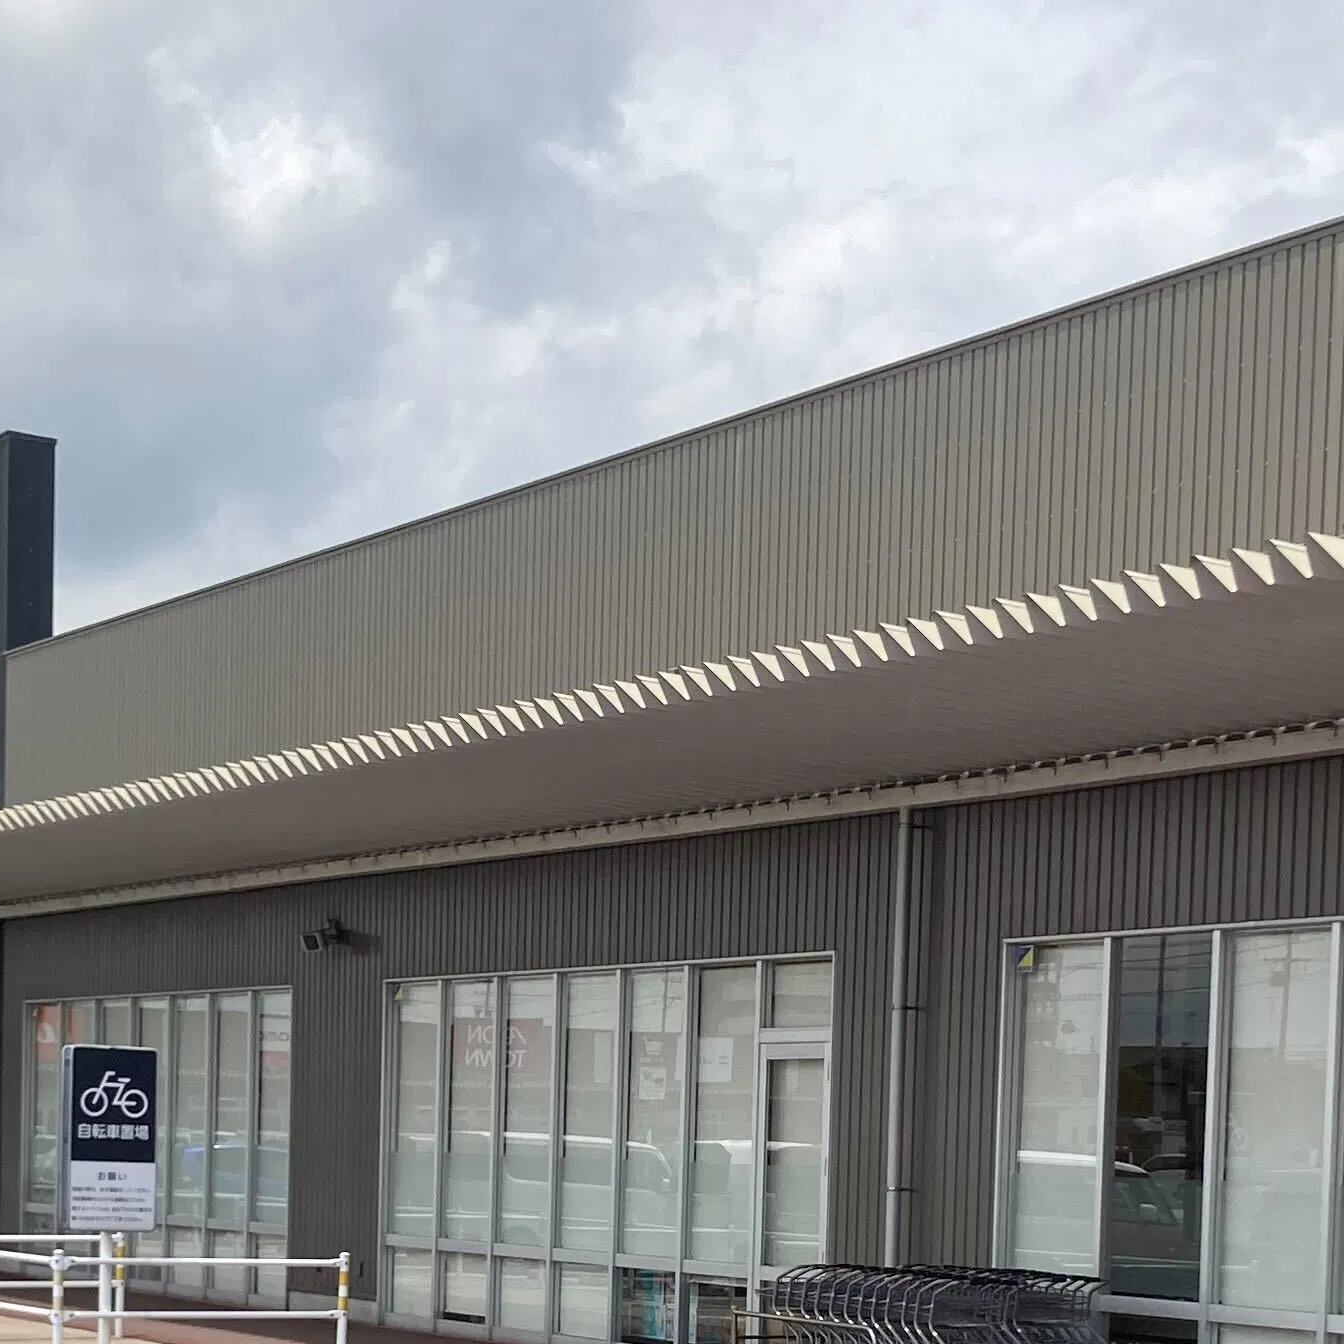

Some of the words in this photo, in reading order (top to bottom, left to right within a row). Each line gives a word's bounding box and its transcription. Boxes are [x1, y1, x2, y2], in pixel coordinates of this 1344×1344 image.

[77, 1123, 149, 1141] 自転車置場
